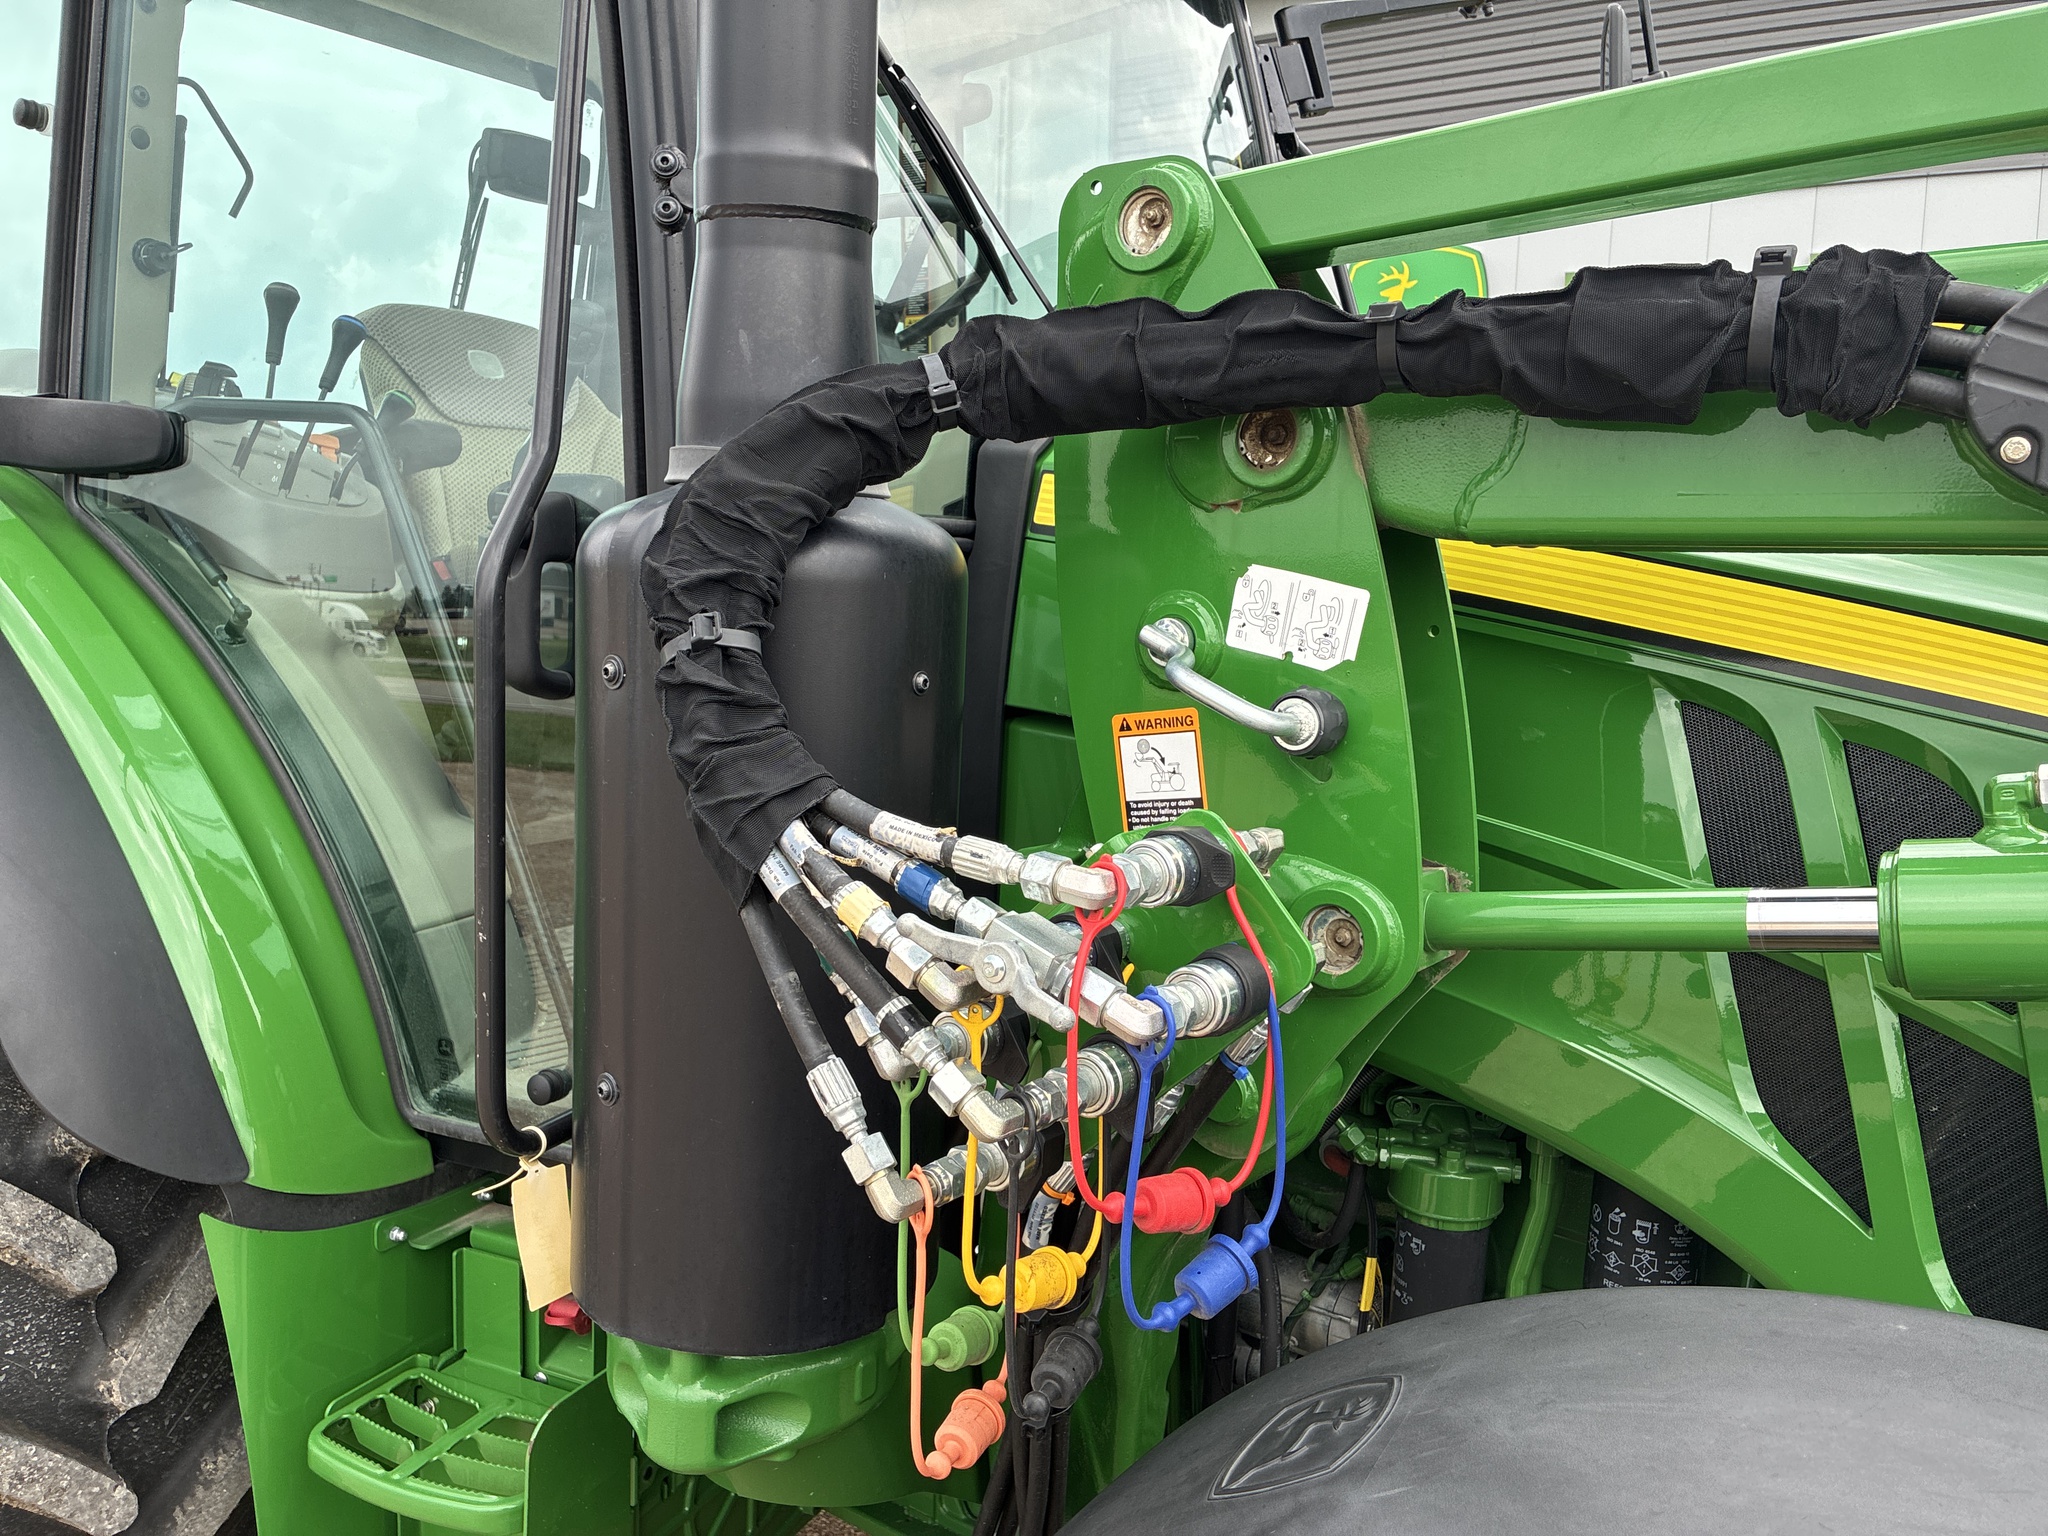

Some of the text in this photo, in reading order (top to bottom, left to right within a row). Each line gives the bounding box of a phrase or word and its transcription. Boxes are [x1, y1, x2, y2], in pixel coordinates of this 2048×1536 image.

[1134, 715, 1194, 730] WARNING
[889, 825, 905, 834] MADE
[913, 832, 938, 842] MEXICO
[873, 845, 889, 856] MADE
[776, 861, 789, 877] MADE
